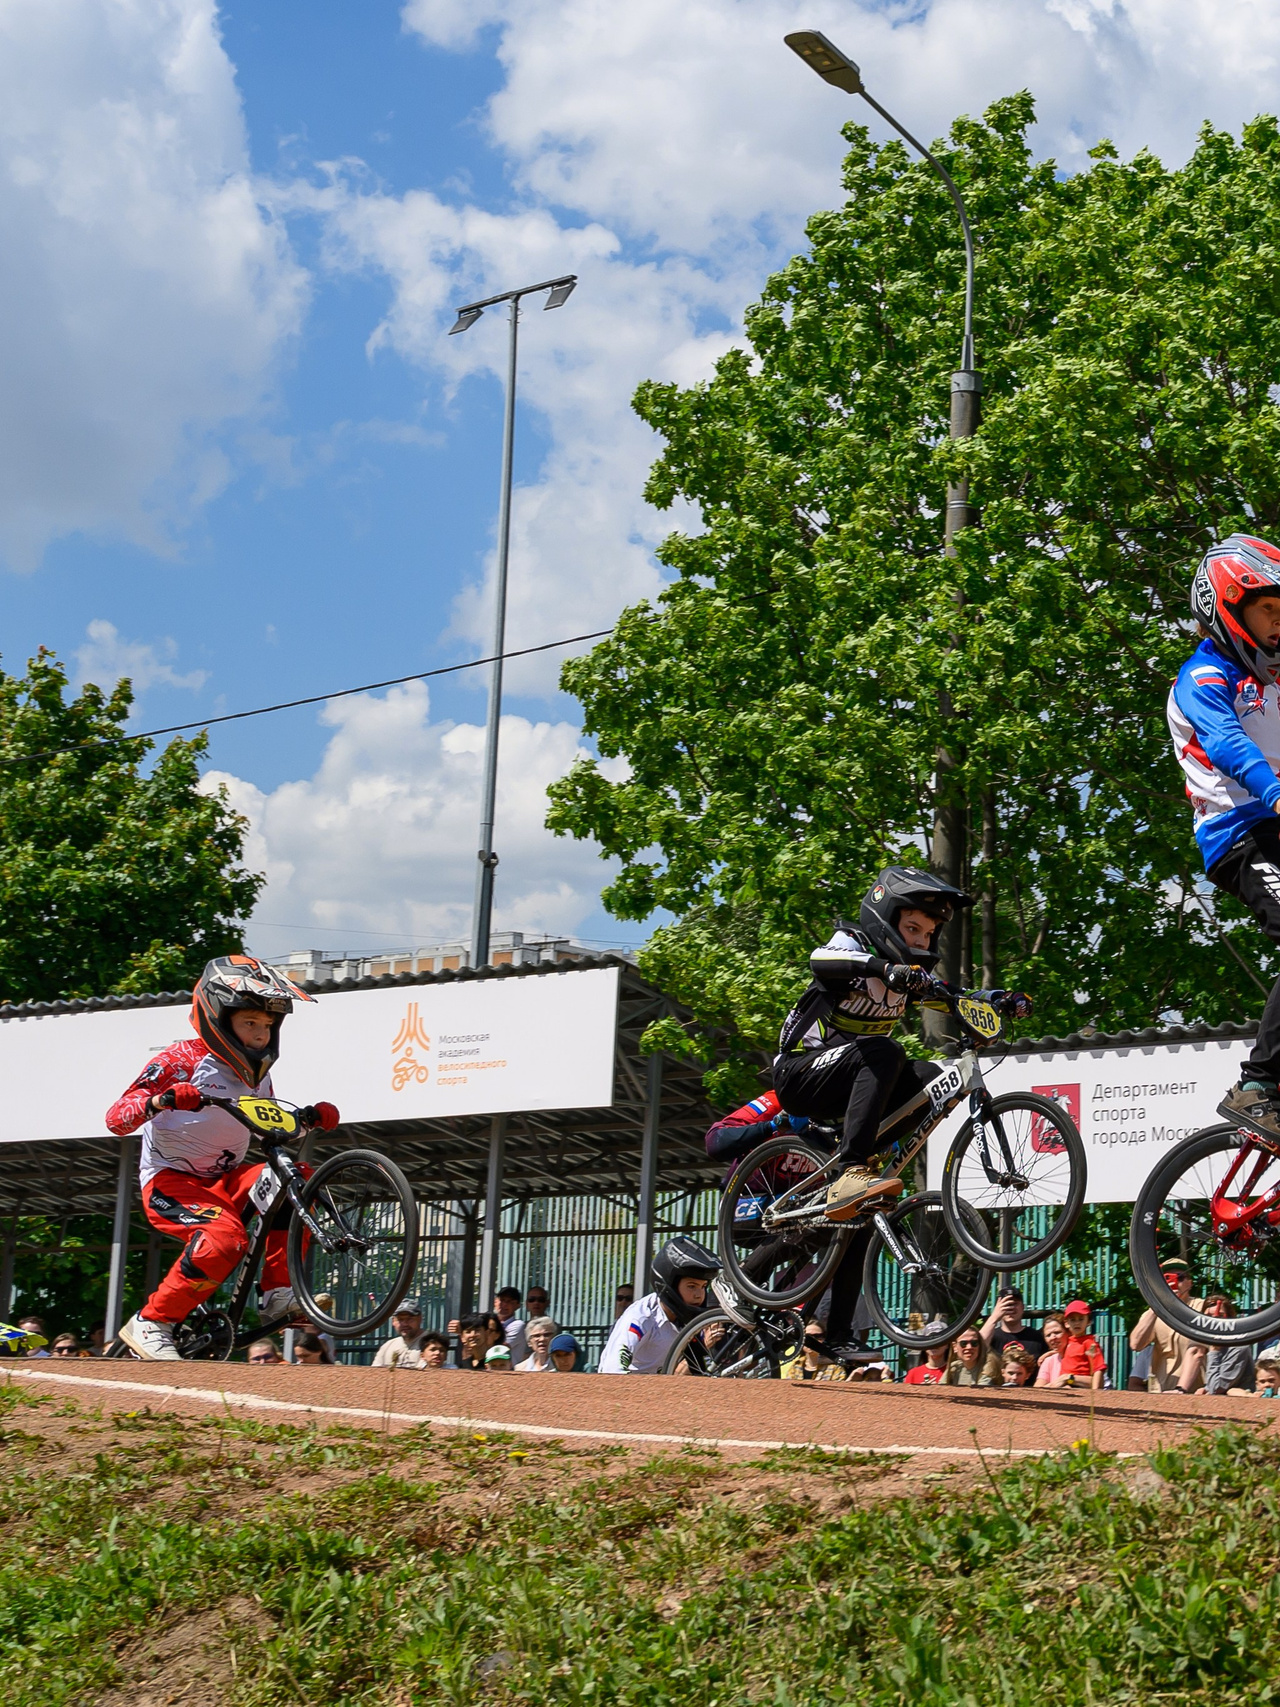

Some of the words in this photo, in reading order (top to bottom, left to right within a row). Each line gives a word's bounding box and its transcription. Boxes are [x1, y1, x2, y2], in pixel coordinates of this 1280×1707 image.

[970, 1007, 996, 1032] 858
[439, 1033, 490, 1044] Московская
[438, 1047, 480, 1058] академия
[437, 1060, 507, 1071] велосипедного
[437, 1076, 468, 1086] спорта
[931, 1071, 960, 1102] 858
[1092, 1081, 1197, 1102] Департамент
[254, 1105, 283, 1123] 63
[1092, 1107, 1146, 1125] спорта
[892, 1110, 940, 1169] MEYB
[1092, 1129, 1147, 1148] города
[1151, 1126, 1204, 1141] Моск
[257, 1177, 272, 1201] 63
[883, 1229, 903, 1261] ANSWER
[1190, 1315, 1236, 1332] AVIAN
